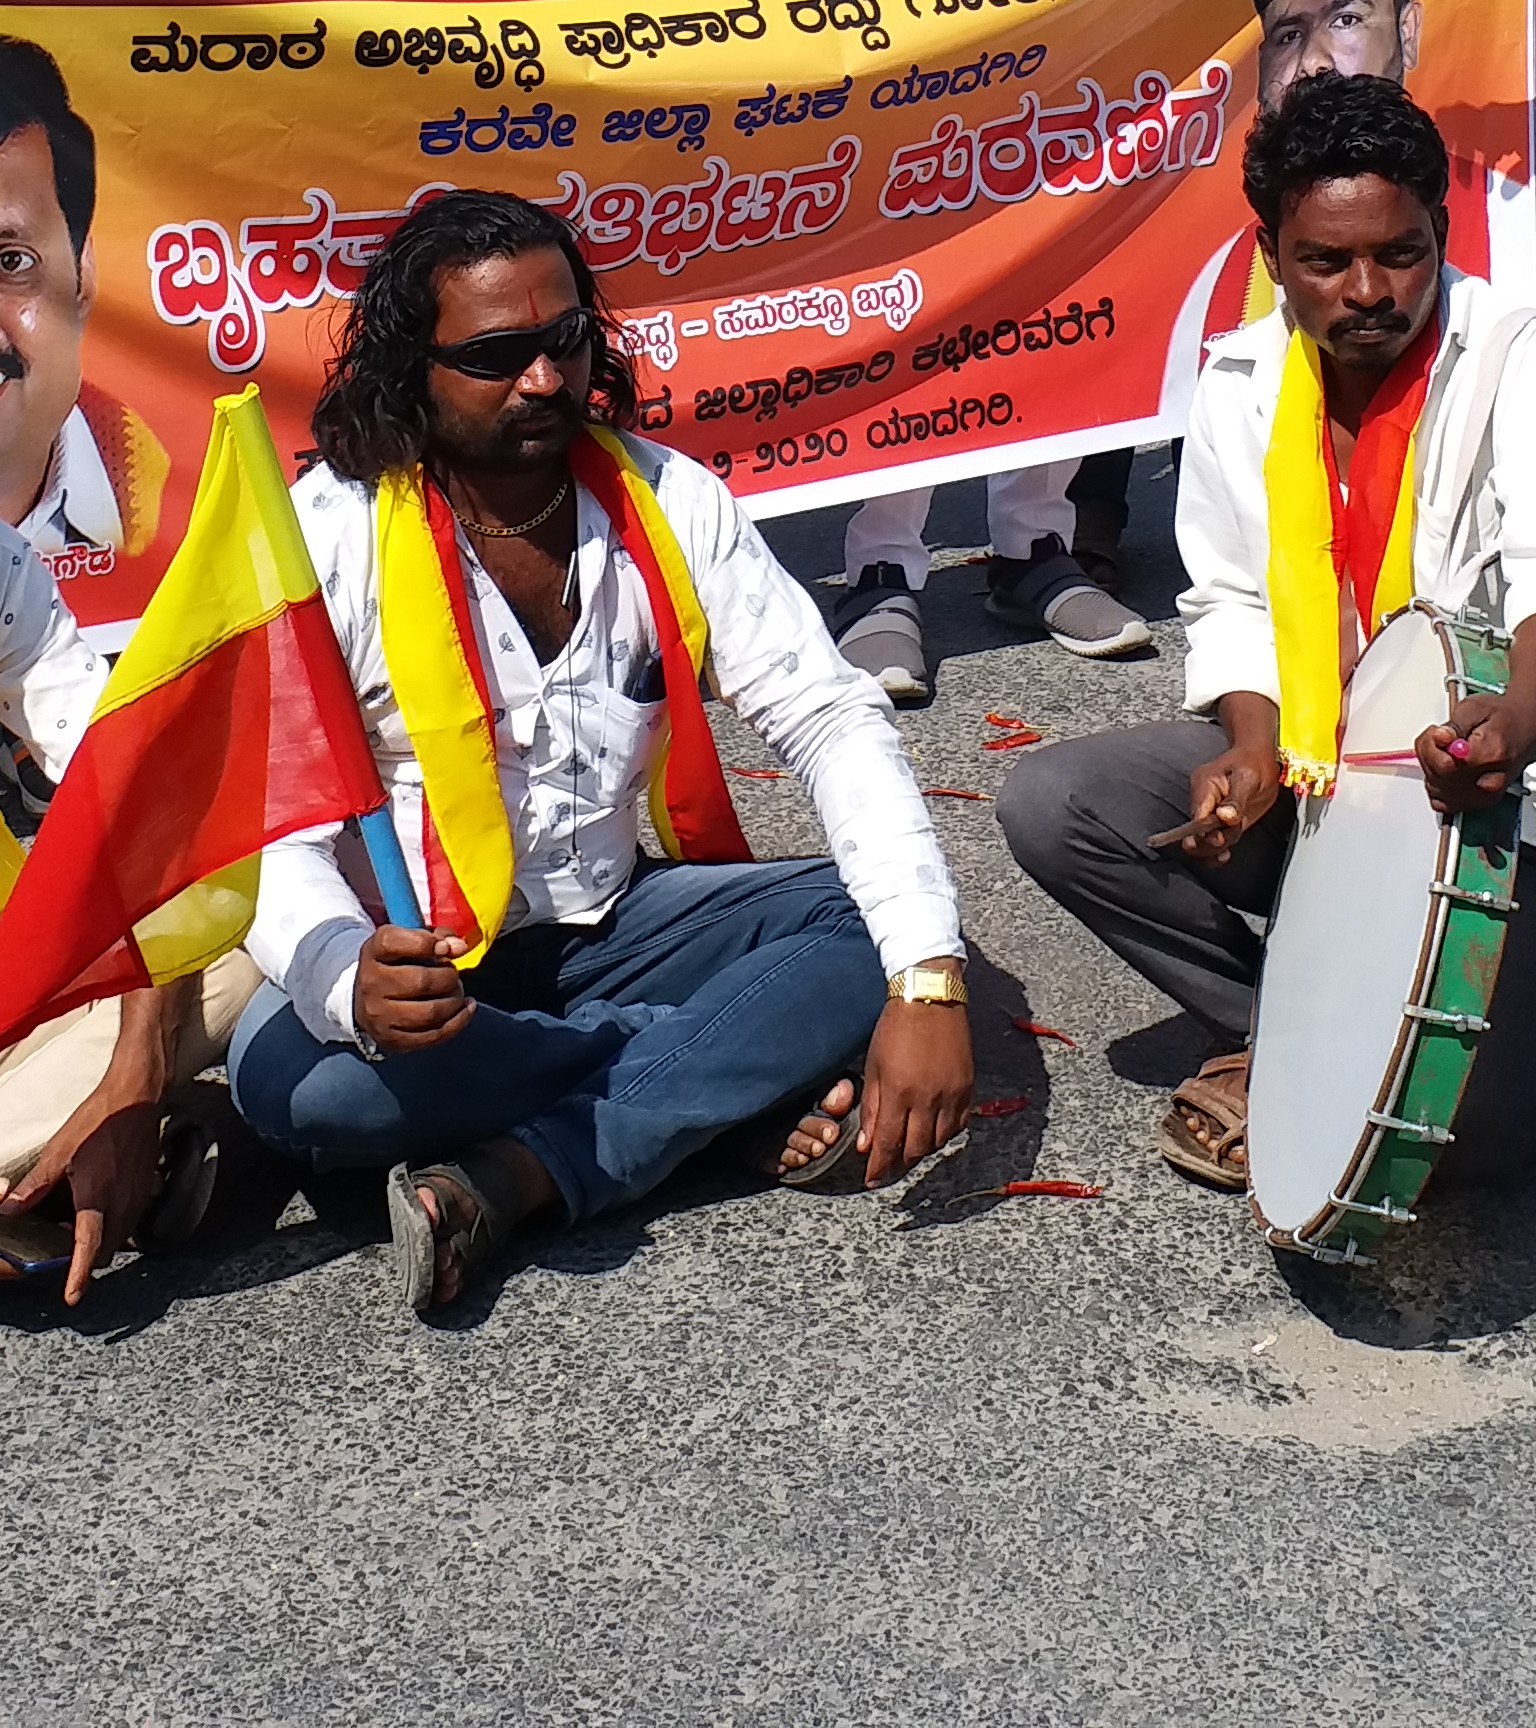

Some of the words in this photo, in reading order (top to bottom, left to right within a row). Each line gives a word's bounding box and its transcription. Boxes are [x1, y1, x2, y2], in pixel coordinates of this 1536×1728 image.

[131, 18, 326, 73] ಮರಾಠ
[354, 15, 547, 93] ಅಭಿವೃದ್ಧಿ
[418, 102, 578, 156] ಕರವೇ
[600, 101, 712, 152] ಜಿಲ್ಲಾ
[733, 76, 853, 138] ಘಟಕ
[870, 44, 1048, 111] ಯಾದಗಿರಿ
[694, 349, 896, 423] ಜಿಲ್ಲಾಧಿಕಾರಿ
[867, 392, 1023, 450] ಯಾದಗಿರಿ.
